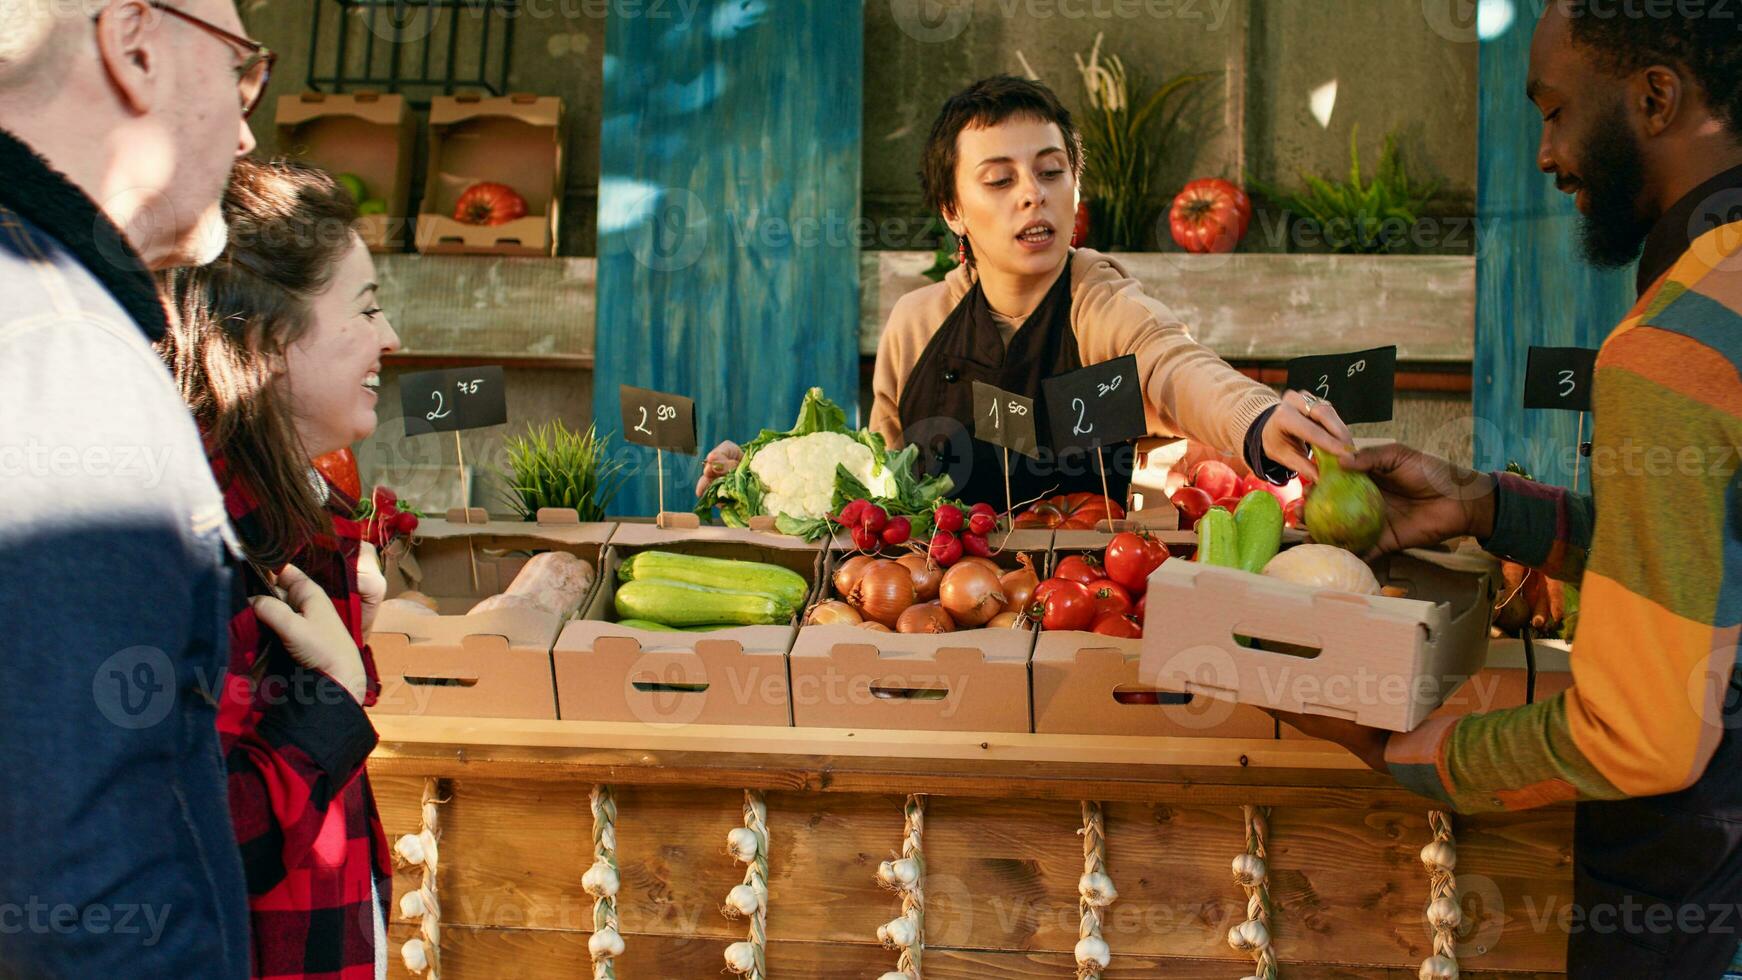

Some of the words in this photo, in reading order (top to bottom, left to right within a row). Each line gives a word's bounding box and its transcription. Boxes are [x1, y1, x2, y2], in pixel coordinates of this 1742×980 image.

[1315, 374, 1329, 400] 3
[1558, 370, 1575, 396] 3
[426, 390, 452, 420] 2
[457, 379, 484, 394] 75
[989, 398, 999, 428] 1
[1008, 401, 1027, 416] 50
[1072, 398, 1093, 436] 2
[1097, 375, 1122, 397] 30
[634, 406, 652, 435] 2
[657, 404, 676, 421] 90
